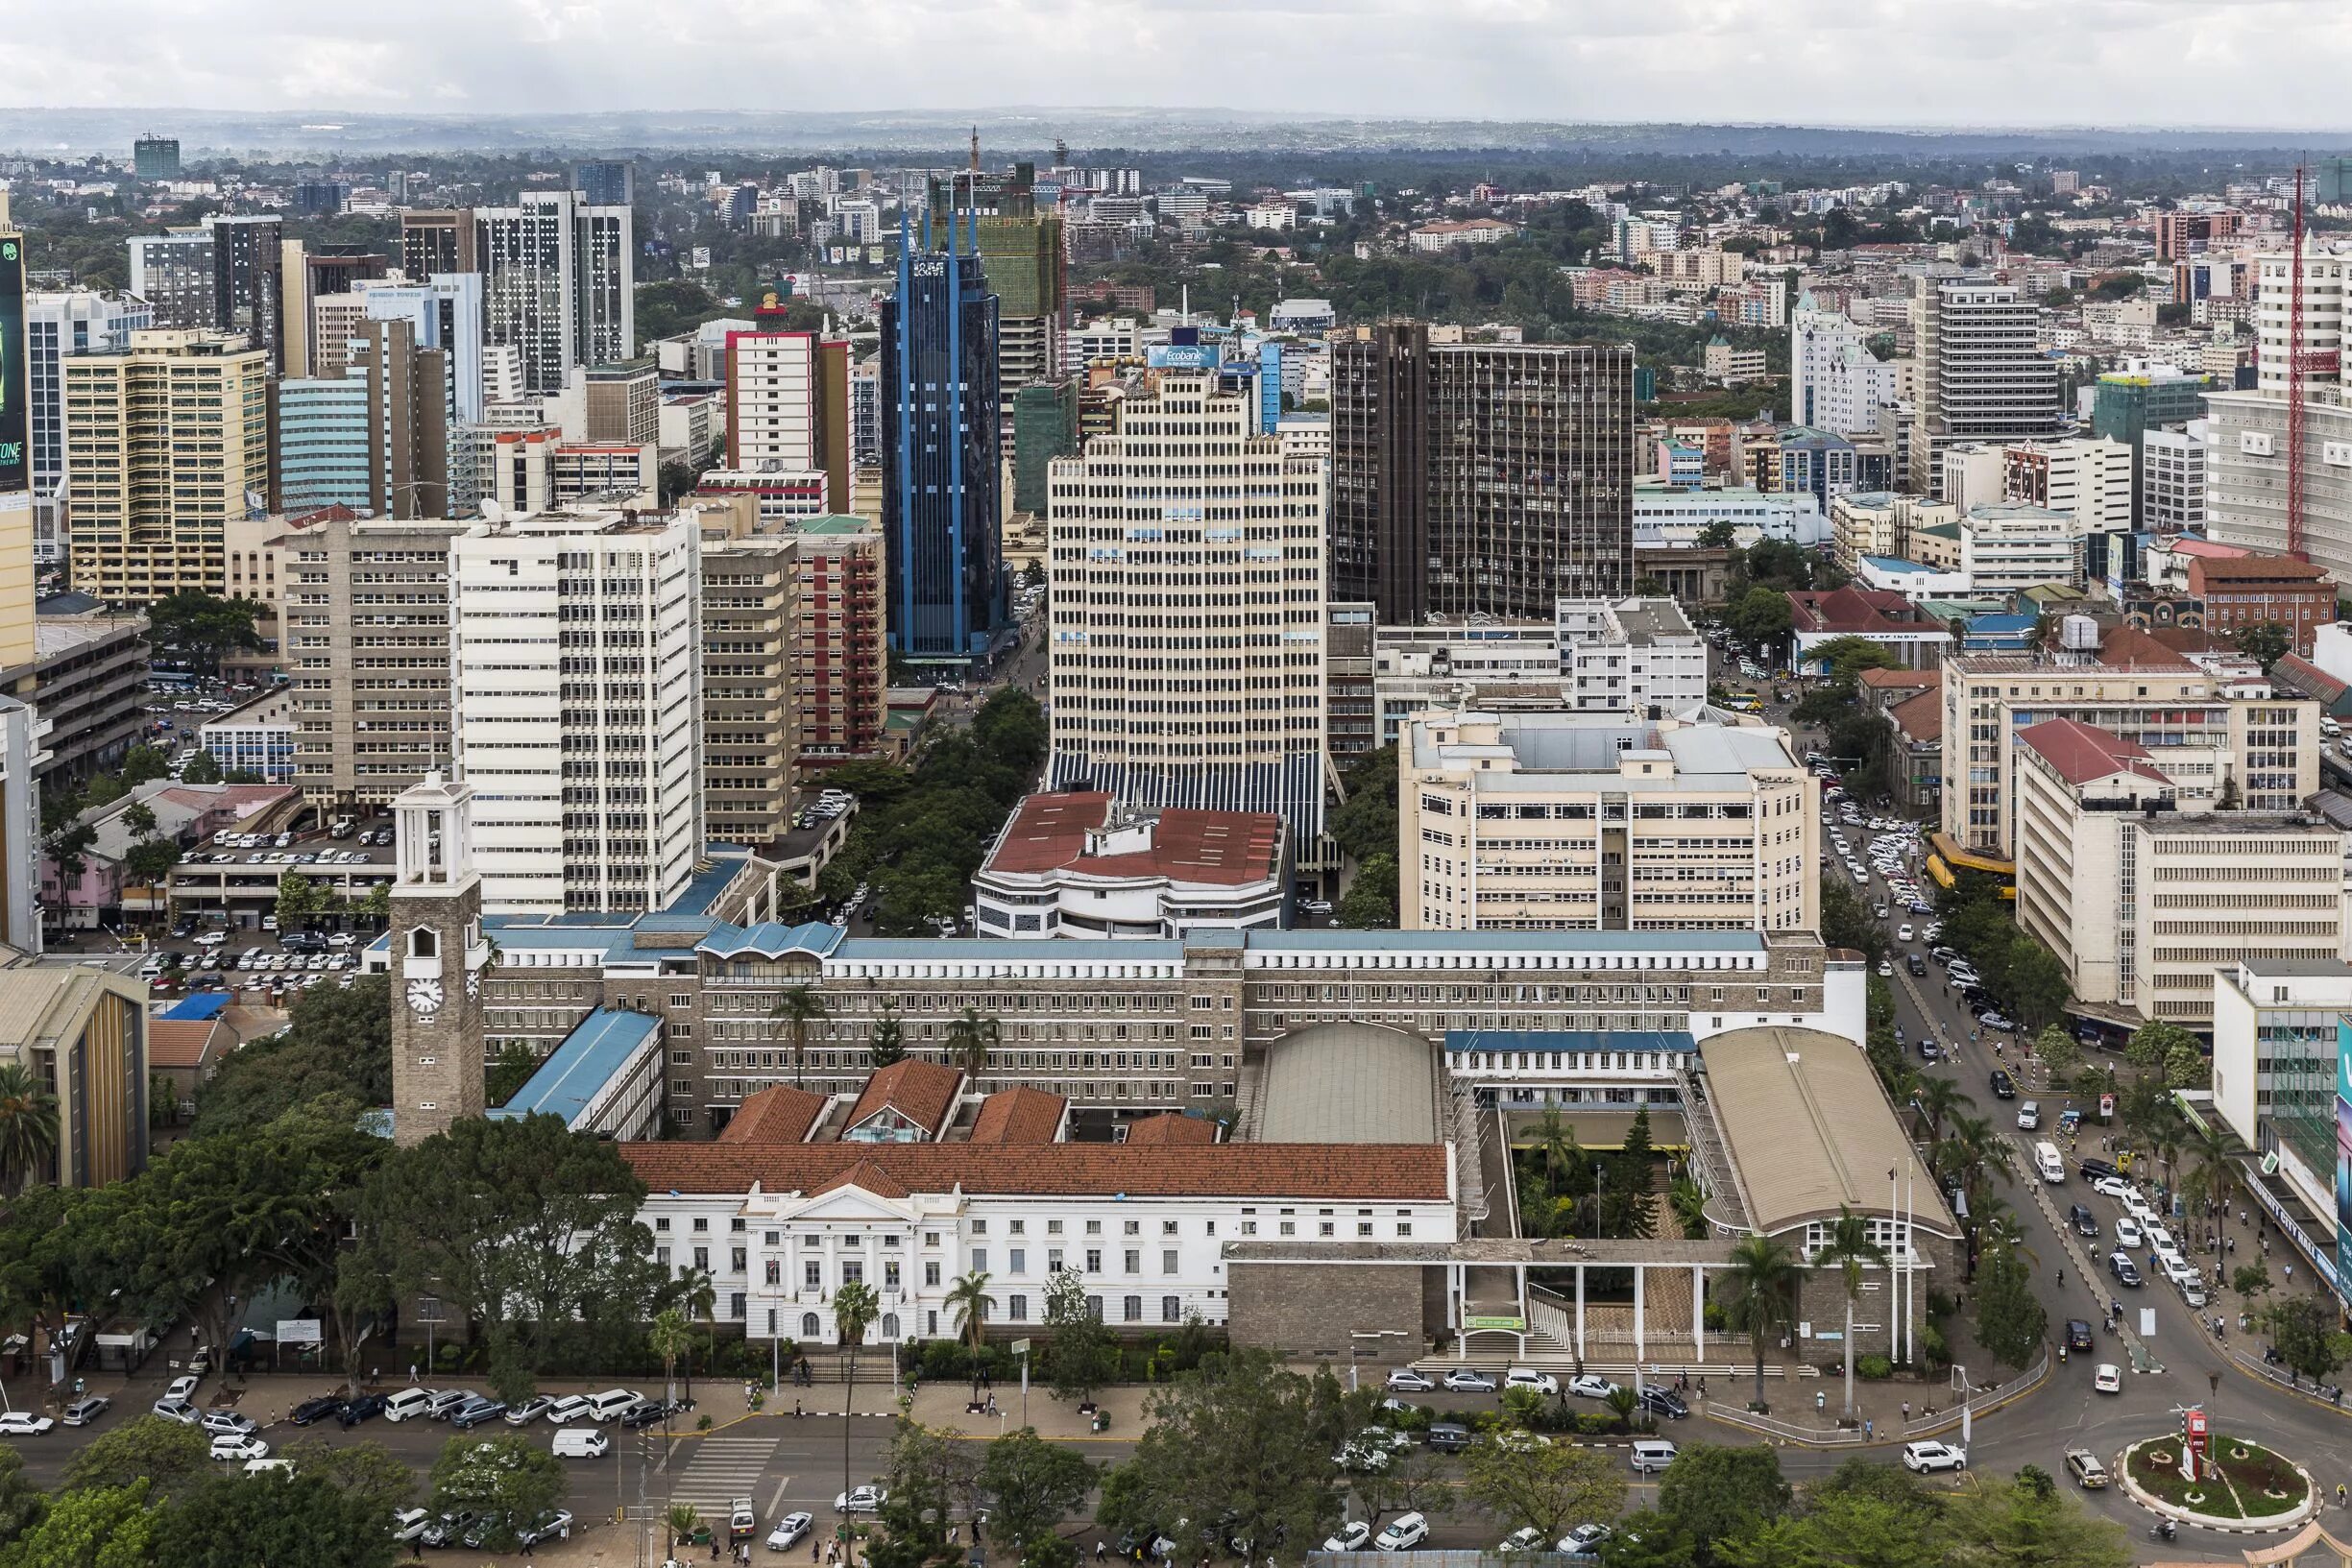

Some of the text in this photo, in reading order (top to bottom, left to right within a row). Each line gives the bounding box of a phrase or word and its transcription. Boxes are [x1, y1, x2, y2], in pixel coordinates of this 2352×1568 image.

[1167, 349, 1200, 360] Ecobank
[2280, 1211, 2297, 1237] CITY
[2297, 1232, 2316, 1260] HALL
